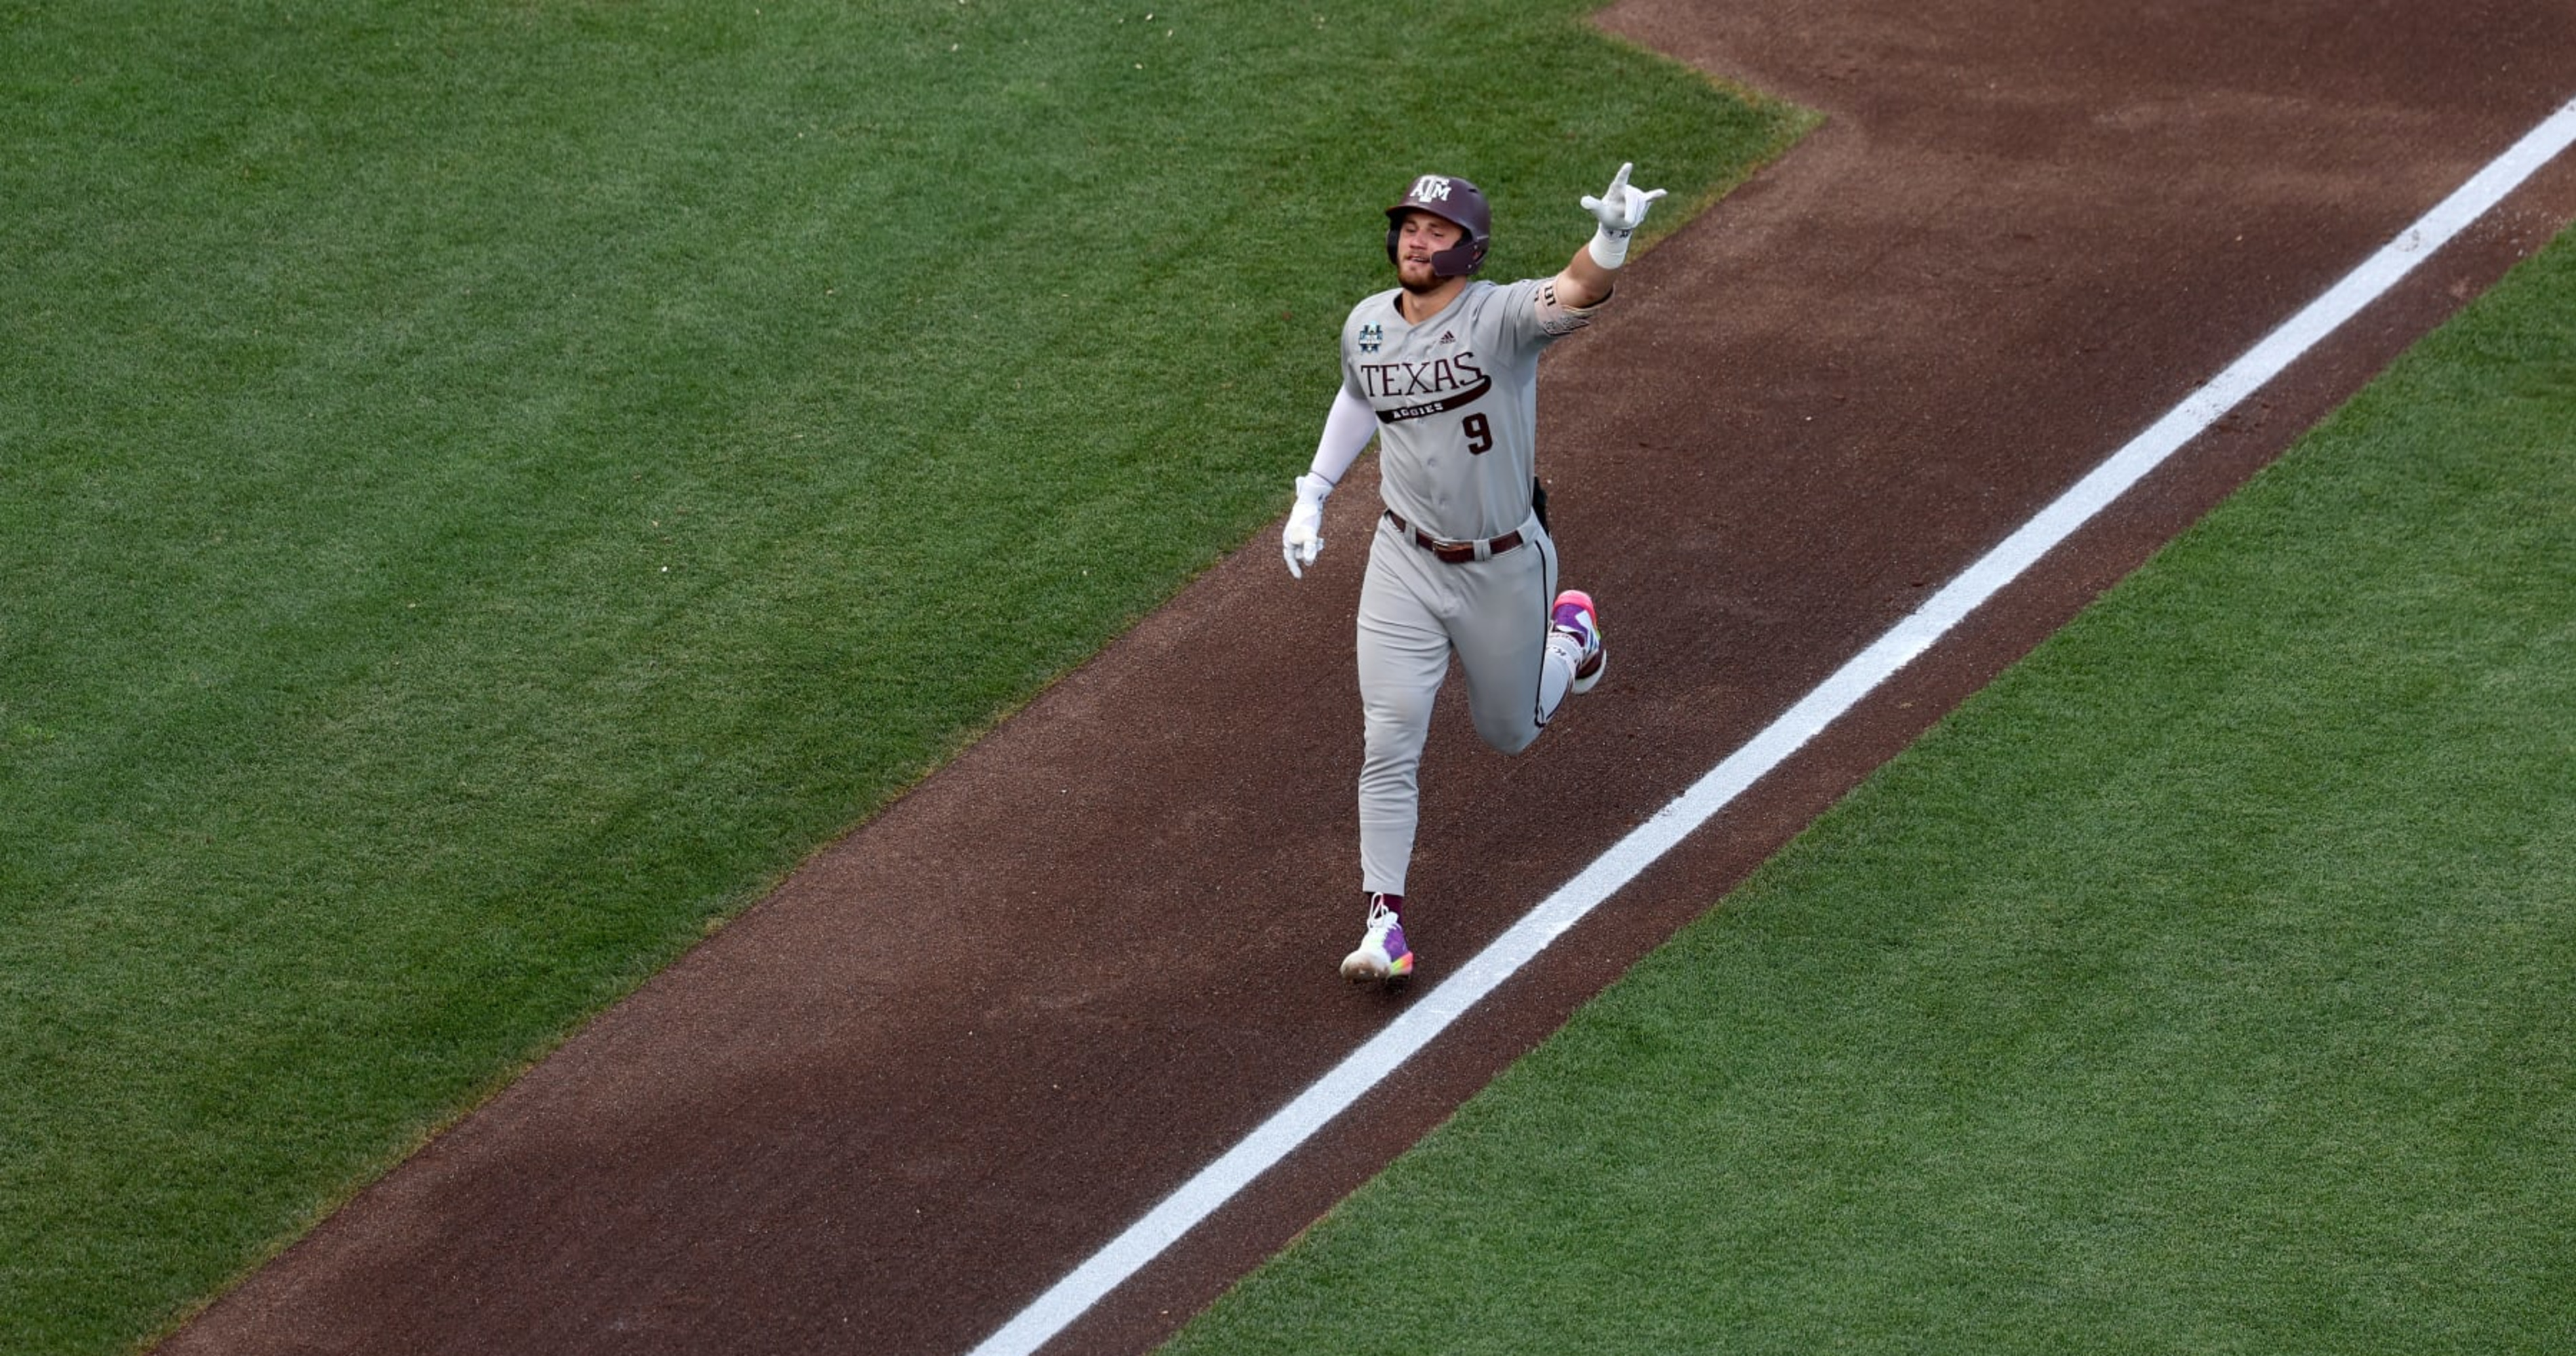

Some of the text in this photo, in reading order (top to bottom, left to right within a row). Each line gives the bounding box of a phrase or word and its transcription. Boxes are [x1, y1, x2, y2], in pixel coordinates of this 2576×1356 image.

[1361, 351, 1484, 397] TEXAS
[1392, 403, 1443, 419] AGGIES
[1462, 412, 1493, 456] 9
